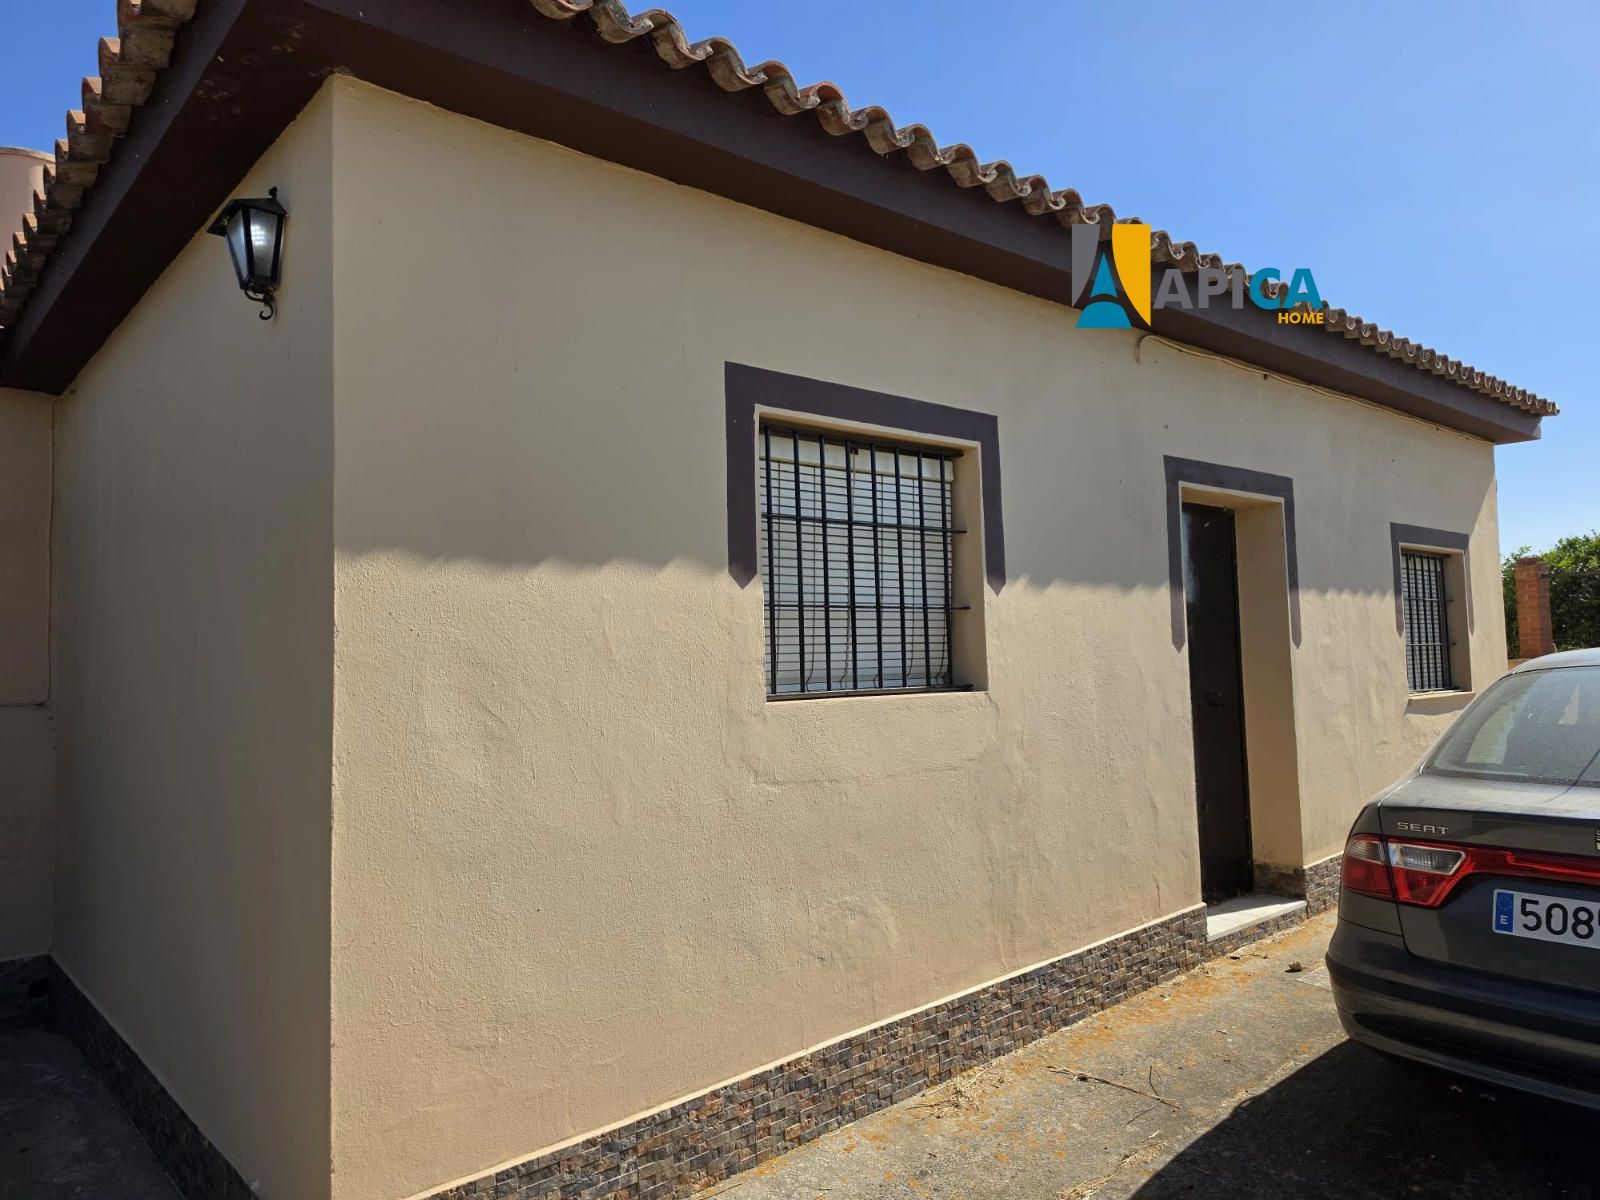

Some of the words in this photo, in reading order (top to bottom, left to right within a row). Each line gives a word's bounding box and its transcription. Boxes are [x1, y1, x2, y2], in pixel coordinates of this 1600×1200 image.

[1397, 821, 1449, 835] SEAT
[1500, 914, 1509, 925] E
[1520, 898, 1600, 940] 508
